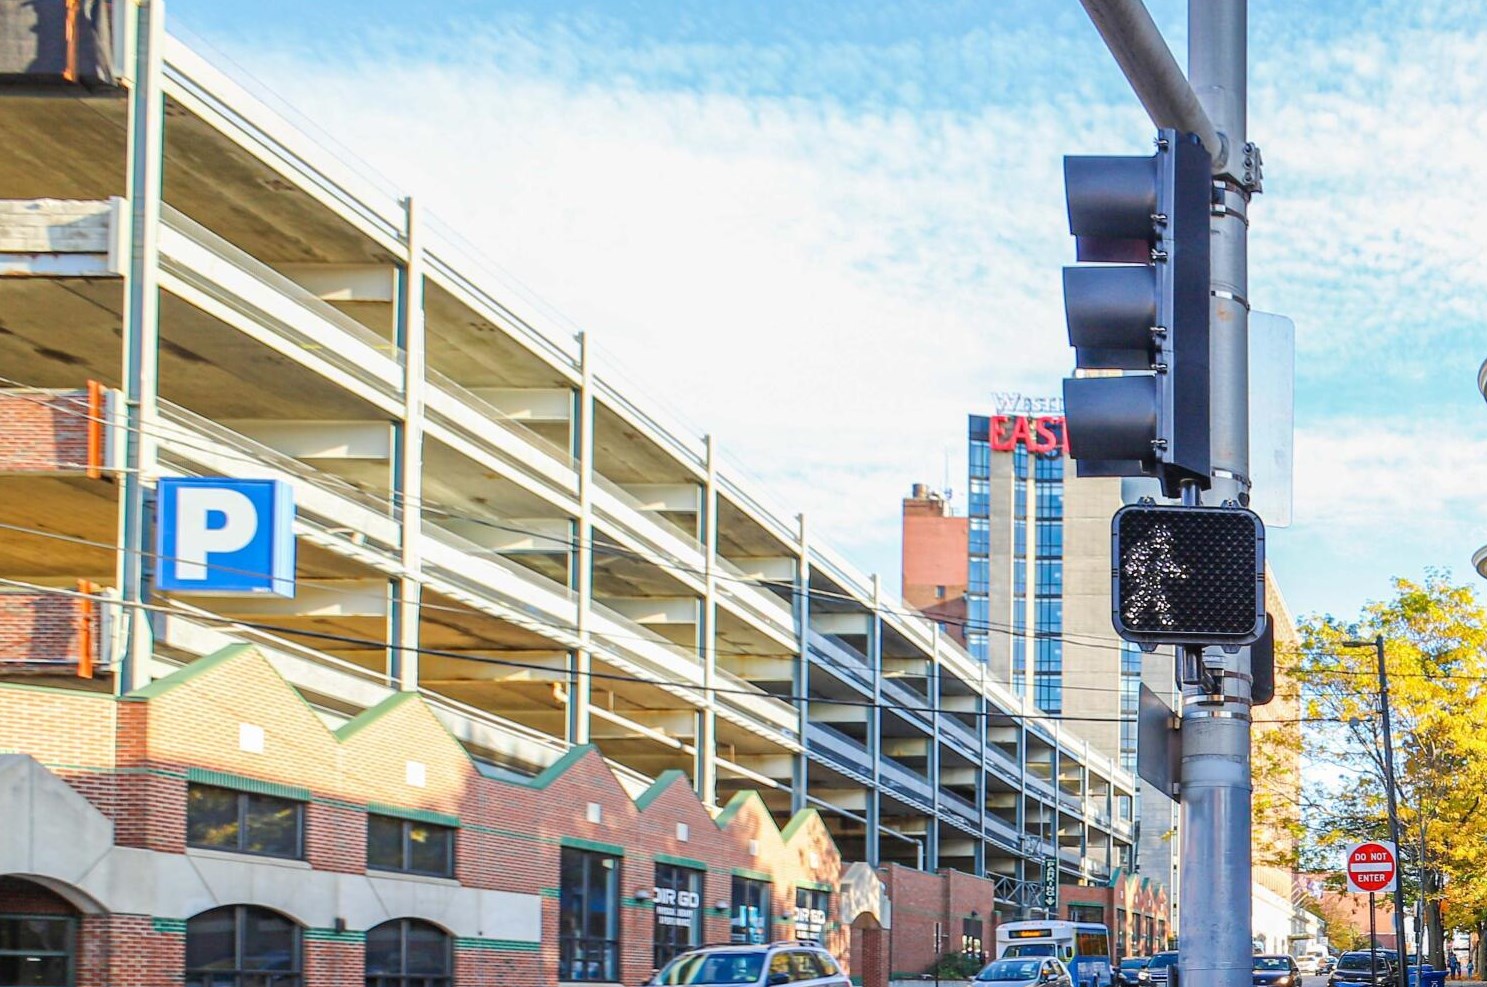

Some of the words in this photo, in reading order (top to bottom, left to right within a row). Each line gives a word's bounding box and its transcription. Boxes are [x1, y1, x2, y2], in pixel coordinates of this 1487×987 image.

[175, 487, 258, 580] P
[1371, 852, 1387, 860] NOT
[1358, 874, 1386, 882] ENTER
